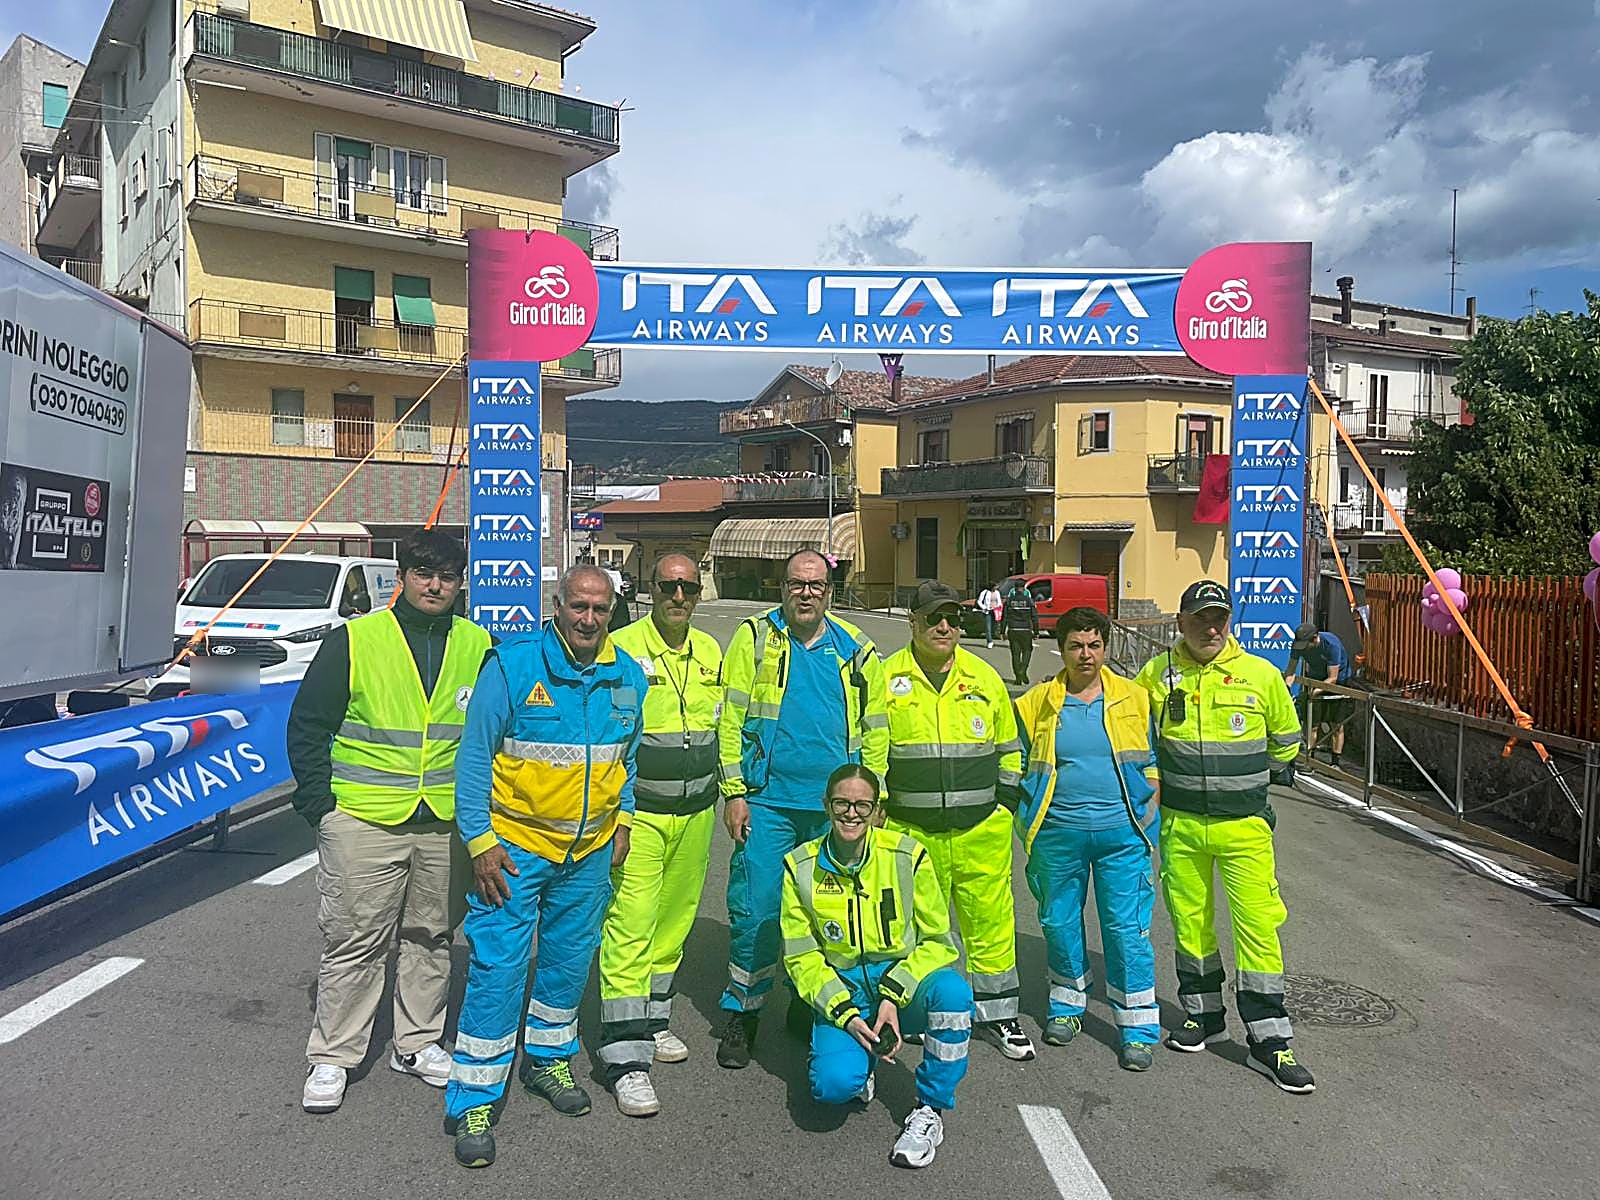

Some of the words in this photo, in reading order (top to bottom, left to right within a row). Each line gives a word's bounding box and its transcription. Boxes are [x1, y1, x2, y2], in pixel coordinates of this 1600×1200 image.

[622, 272, 778, 315] ITA
[807, 276, 962, 317] ITA
[991, 278, 1150, 318] ITA
[509, 301, 539, 325] Giro
[540, 302, 586, 326] d'Italia
[632, 319, 769, 341] AIRWAYS
[816, 323, 953, 344] AIRWAYS
[1001, 324, 1140, 345] AIRWAYS
[1188, 316, 1218, 340] Giro
[1220, 316, 1267, 340] d'Italia
[42, 335, 129, 392] NOLEGGIO
[473, 377, 535, 394] ITA
[38, 384, 68, 411] 030
[70, 392, 125, 428] 7040439
[477, 395, 532, 405] AIRWAYS
[1237, 393, 1302, 410] ITA
[1241, 411, 1299, 420] AIRWAYS
[473, 423, 535, 440] ITA
[478, 441, 532, 451] AIRWAYS
[1236, 439, 1301, 456] ITA
[1241, 457, 1297, 467] AIRWAYS
[474, 469, 535, 485] ITA
[478, 487, 532, 496] AIRWAYS
[1236, 485, 1300, 502] ITA
[40, 500, 67, 510] GRUPPO
[1240, 503, 1297, 512] AIRWAYS
[474, 514, 536, 531] ITA
[478, 532, 532, 541] AIRWAYS
[1235, 531, 1300, 548] ITA
[1239, 549, 1296, 558] AIRWAYS
[474, 559, 536, 576] ITA
[478, 577, 532, 587] AIRWAYS
[1234, 577, 1299, 593] ITA
[1238, 595, 1295, 604] AIRWAYS
[474, 605, 536, 622] ITA
[1234, 622, 1296, 639] ITA
[24, 709, 249, 796] ITA
[88, 742, 266, 847] AIRWAYS
